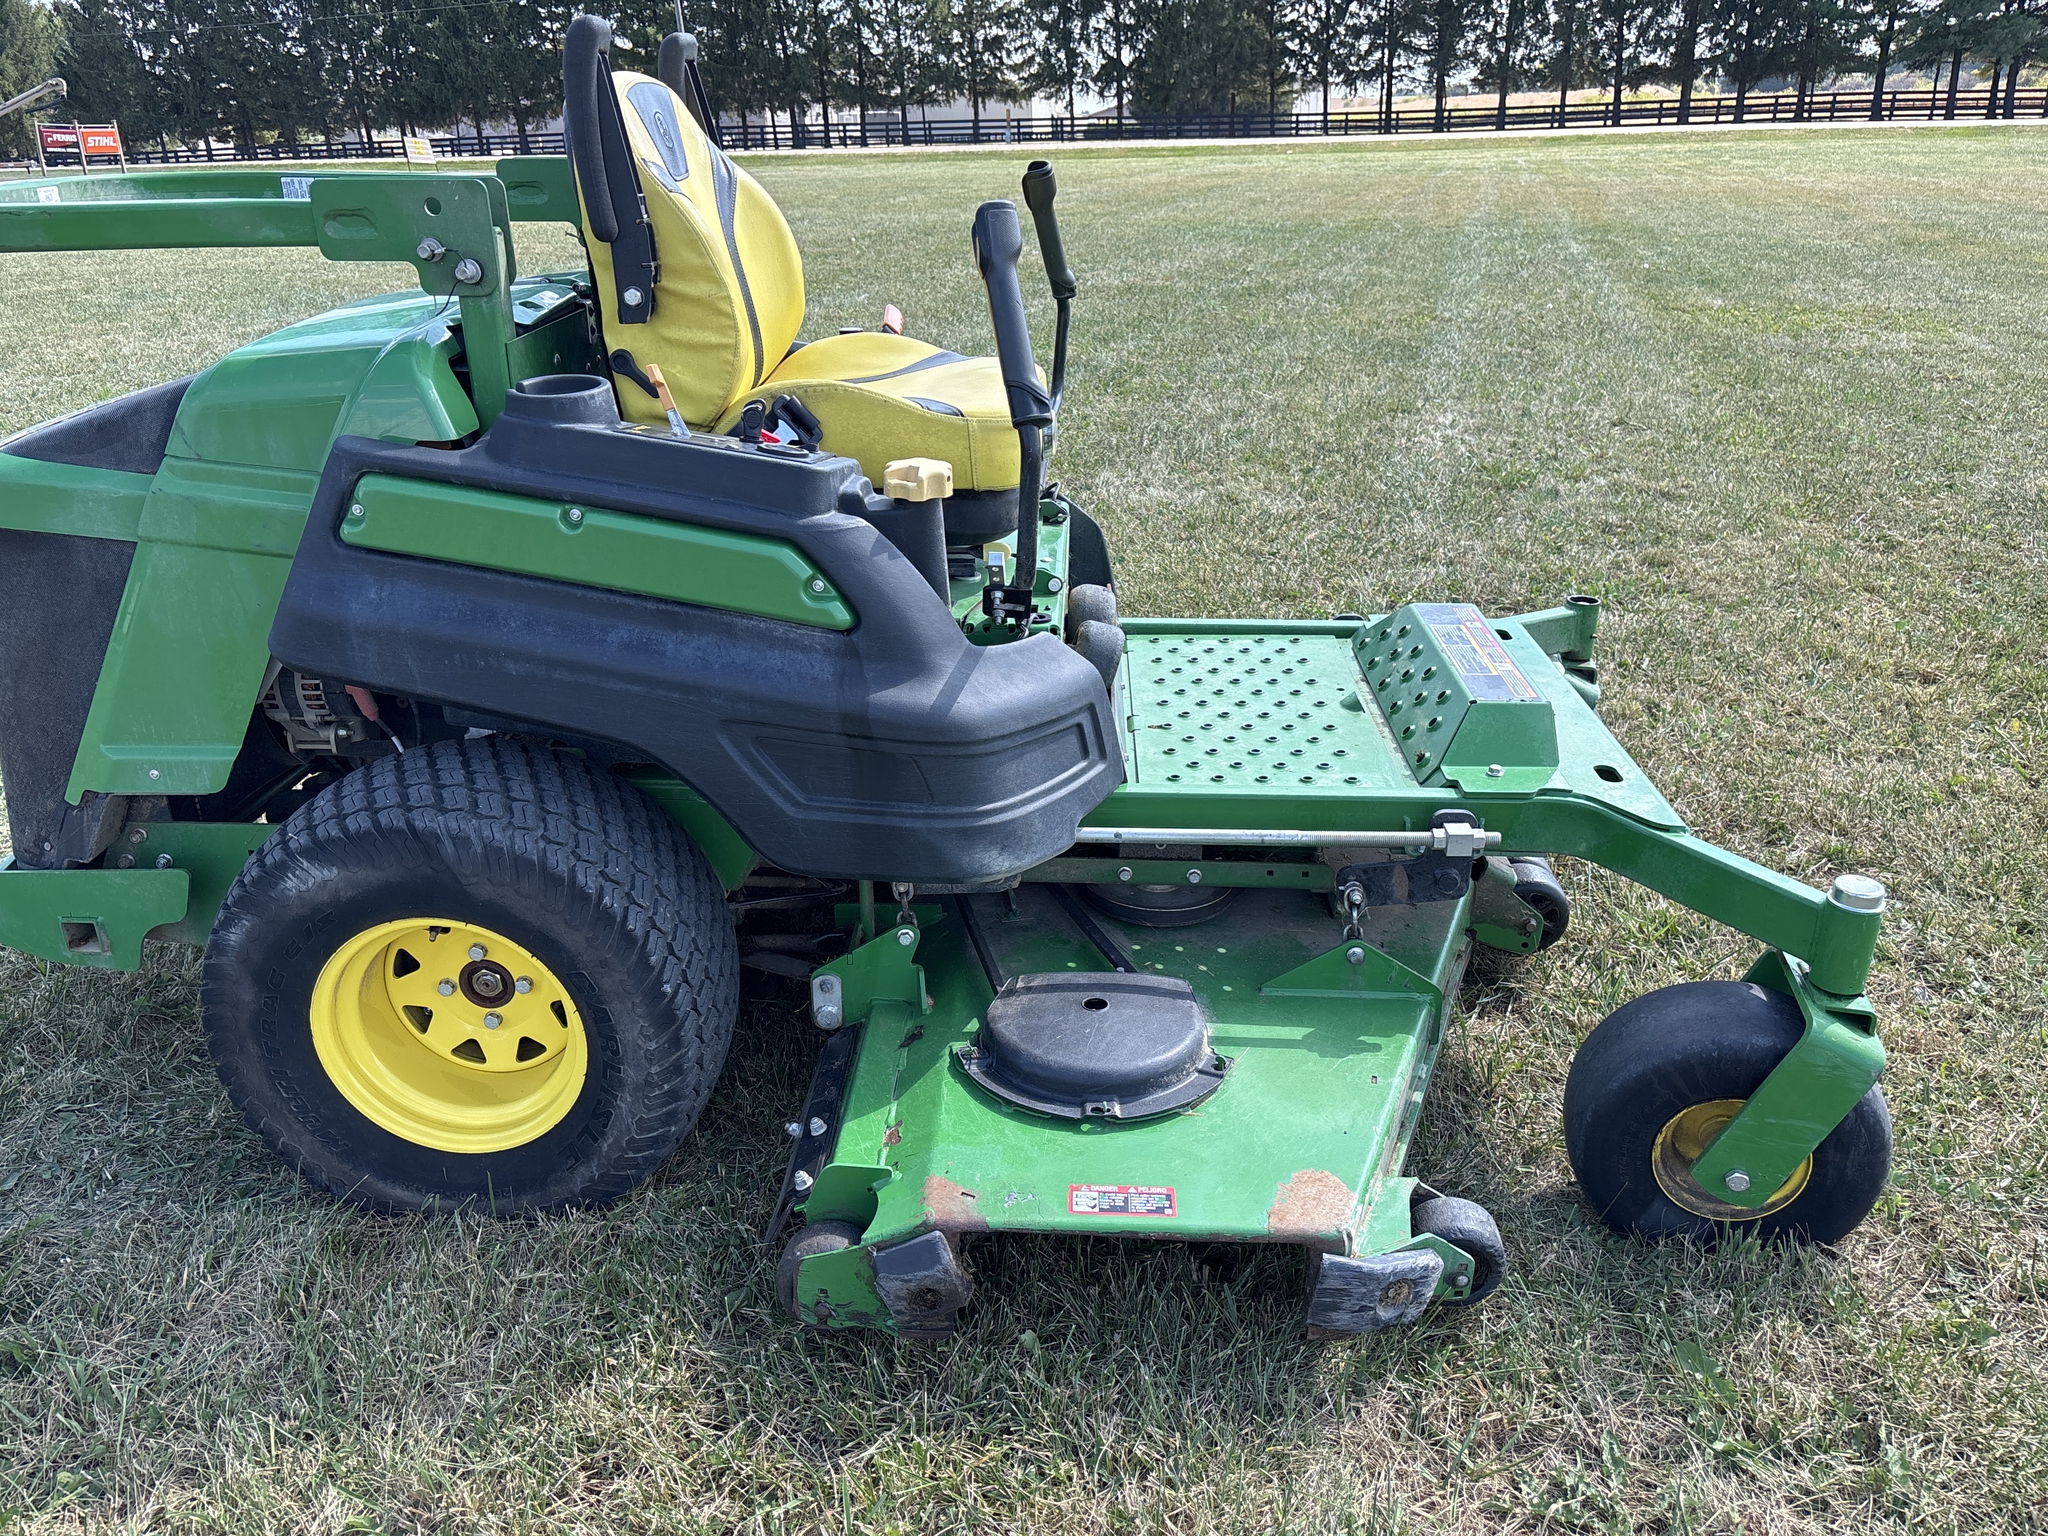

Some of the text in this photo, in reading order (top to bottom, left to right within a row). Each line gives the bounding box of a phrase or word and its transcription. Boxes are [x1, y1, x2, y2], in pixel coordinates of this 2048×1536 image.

[52, 133, 77, 142] FERRIS
[87, 136, 117, 147] STIHL
[260, 966, 286, 1059] TRAC
[557, 970, 624, 1173] CARLISLE
